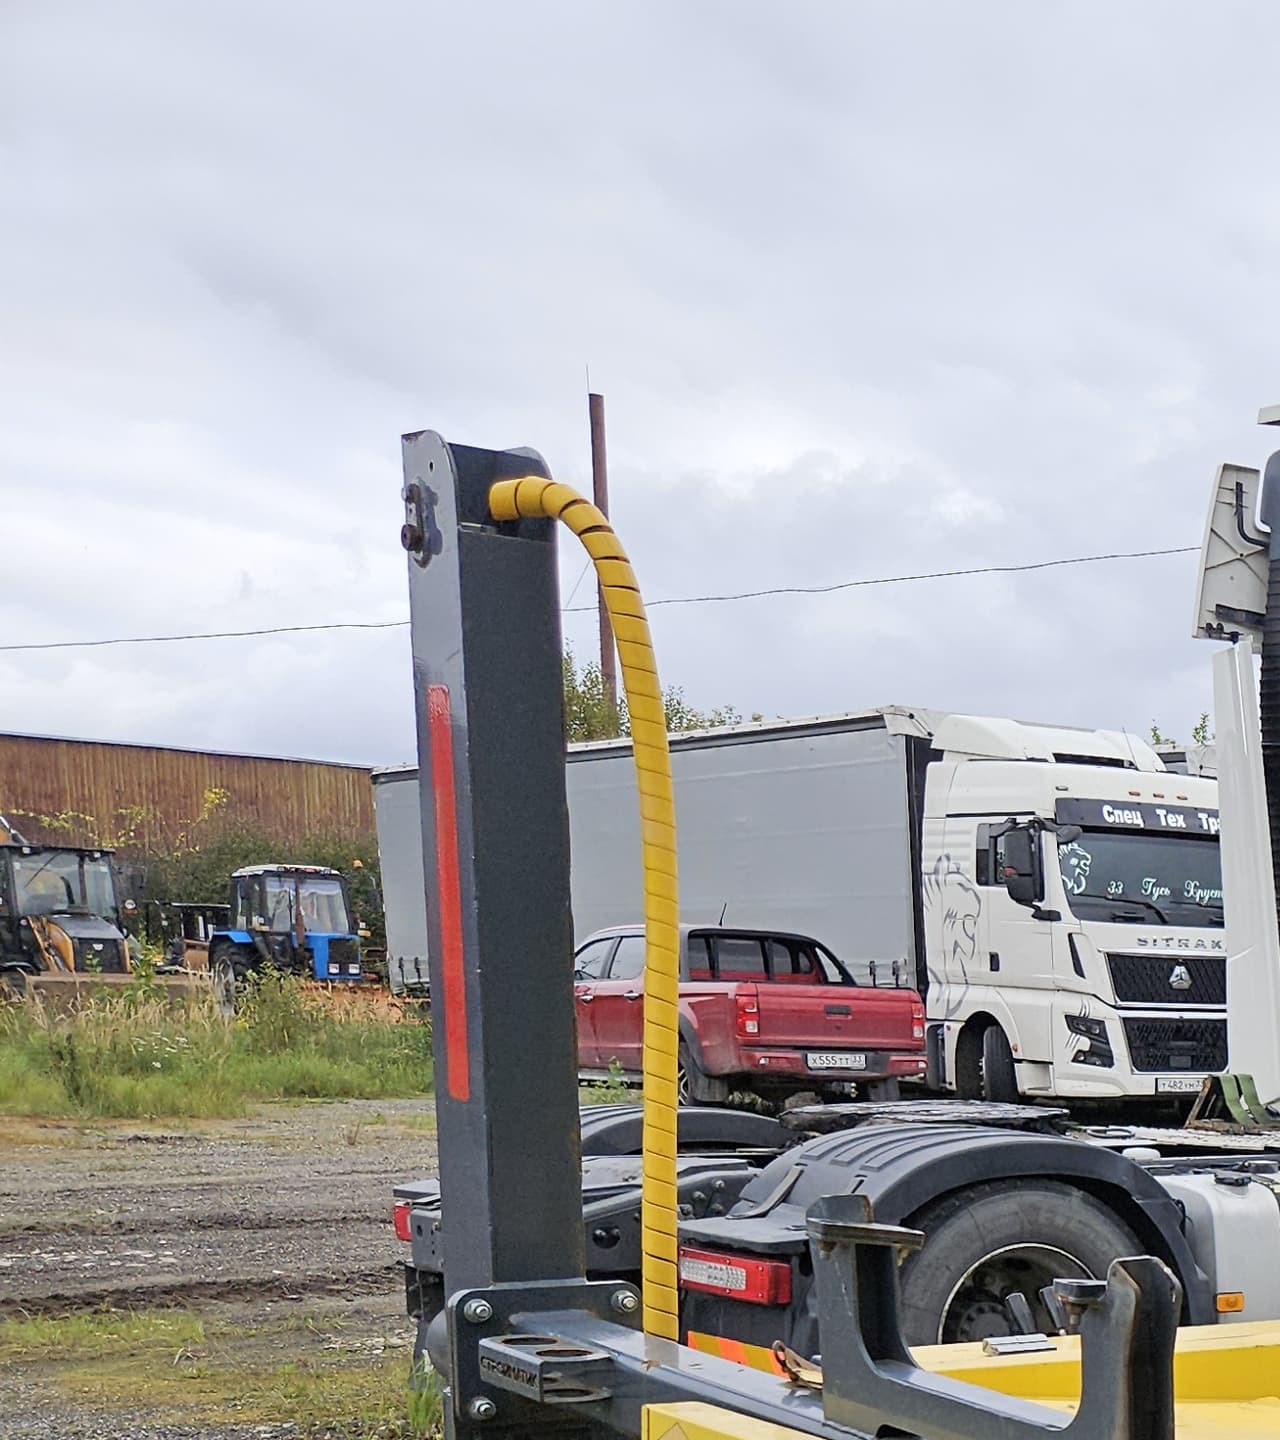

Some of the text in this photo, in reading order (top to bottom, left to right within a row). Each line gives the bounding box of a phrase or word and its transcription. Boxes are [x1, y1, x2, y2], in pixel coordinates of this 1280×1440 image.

[1102, 804, 1145, 829] Спец
[1155, 808, 1187, 829] Тех
[1107, 880, 1124, 895] 33
[1141, 877, 1171, 902] Гусь
[1136, 937, 1223, 950] SITRAK
